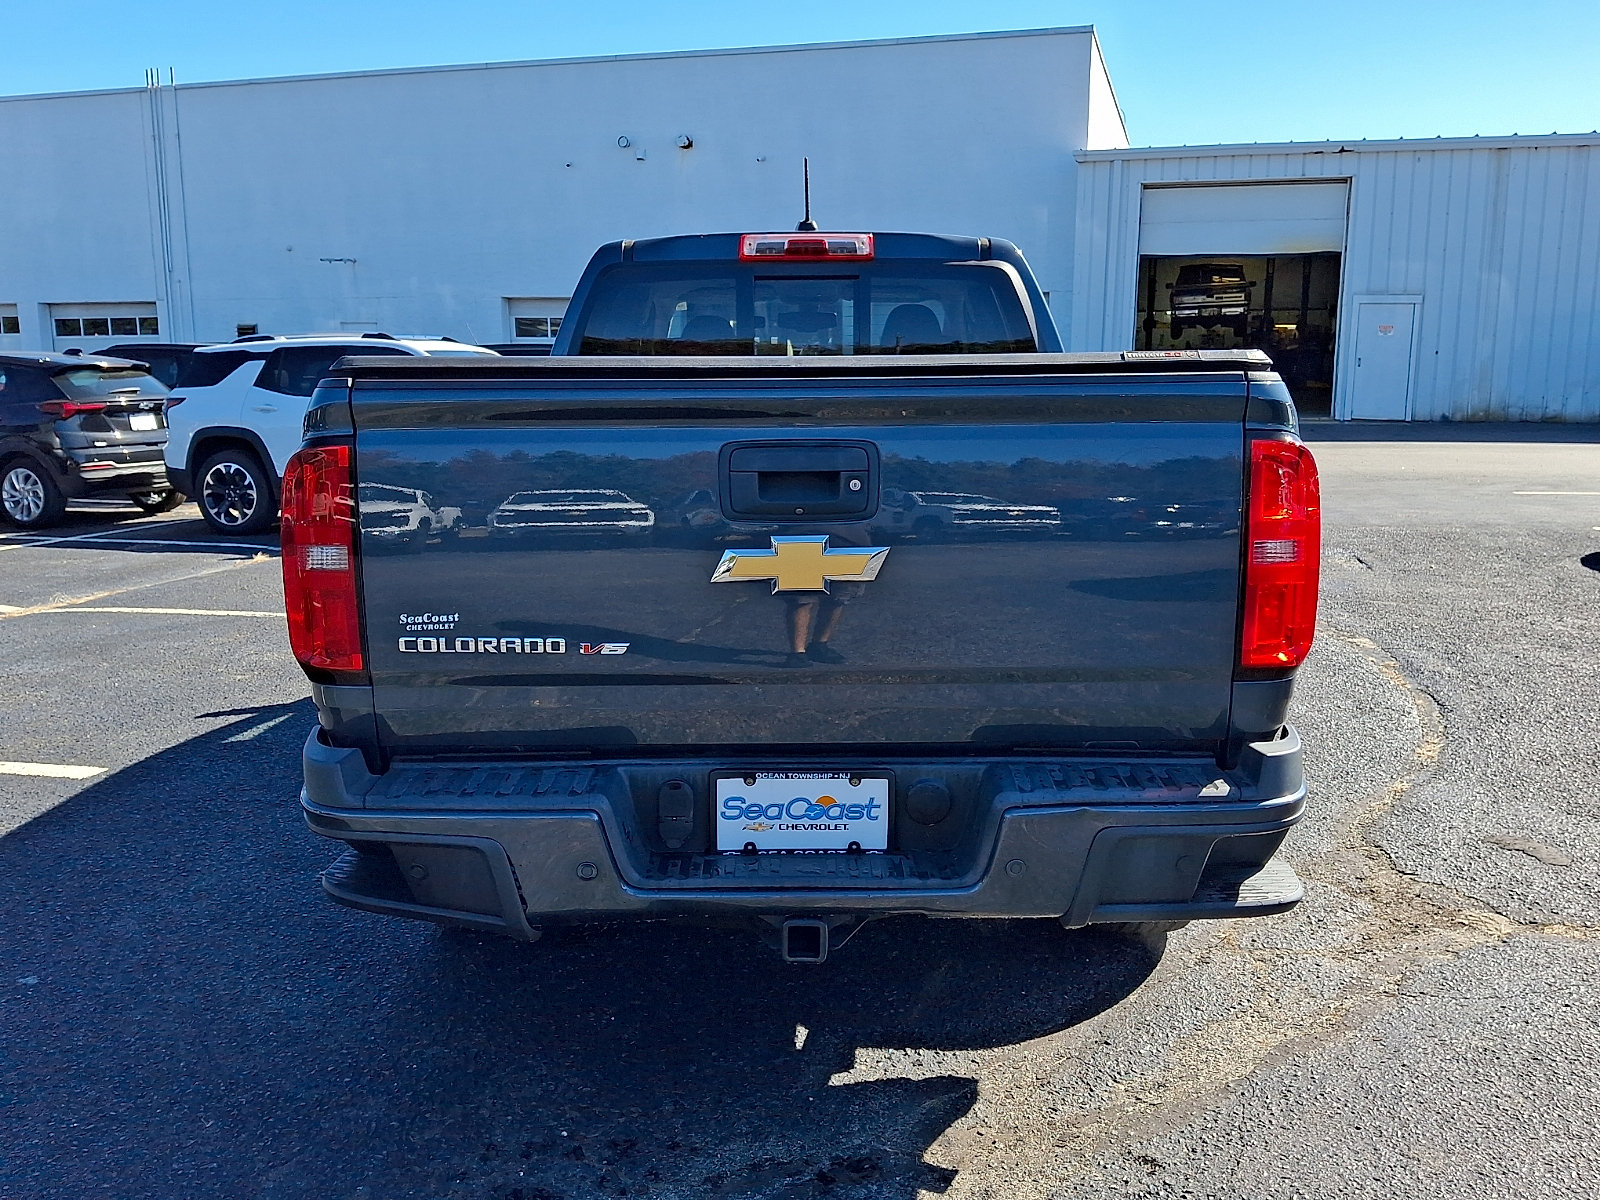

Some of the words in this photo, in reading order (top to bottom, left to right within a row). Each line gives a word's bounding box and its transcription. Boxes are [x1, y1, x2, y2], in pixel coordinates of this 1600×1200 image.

[399, 612, 460, 624] SeaCoast
[406, 623, 455, 631] CHEVROLET
[398, 636, 566, 654] COLORADO
[579, 642, 631, 655] V6
[778, 823, 850, 831] CHEVROLET
